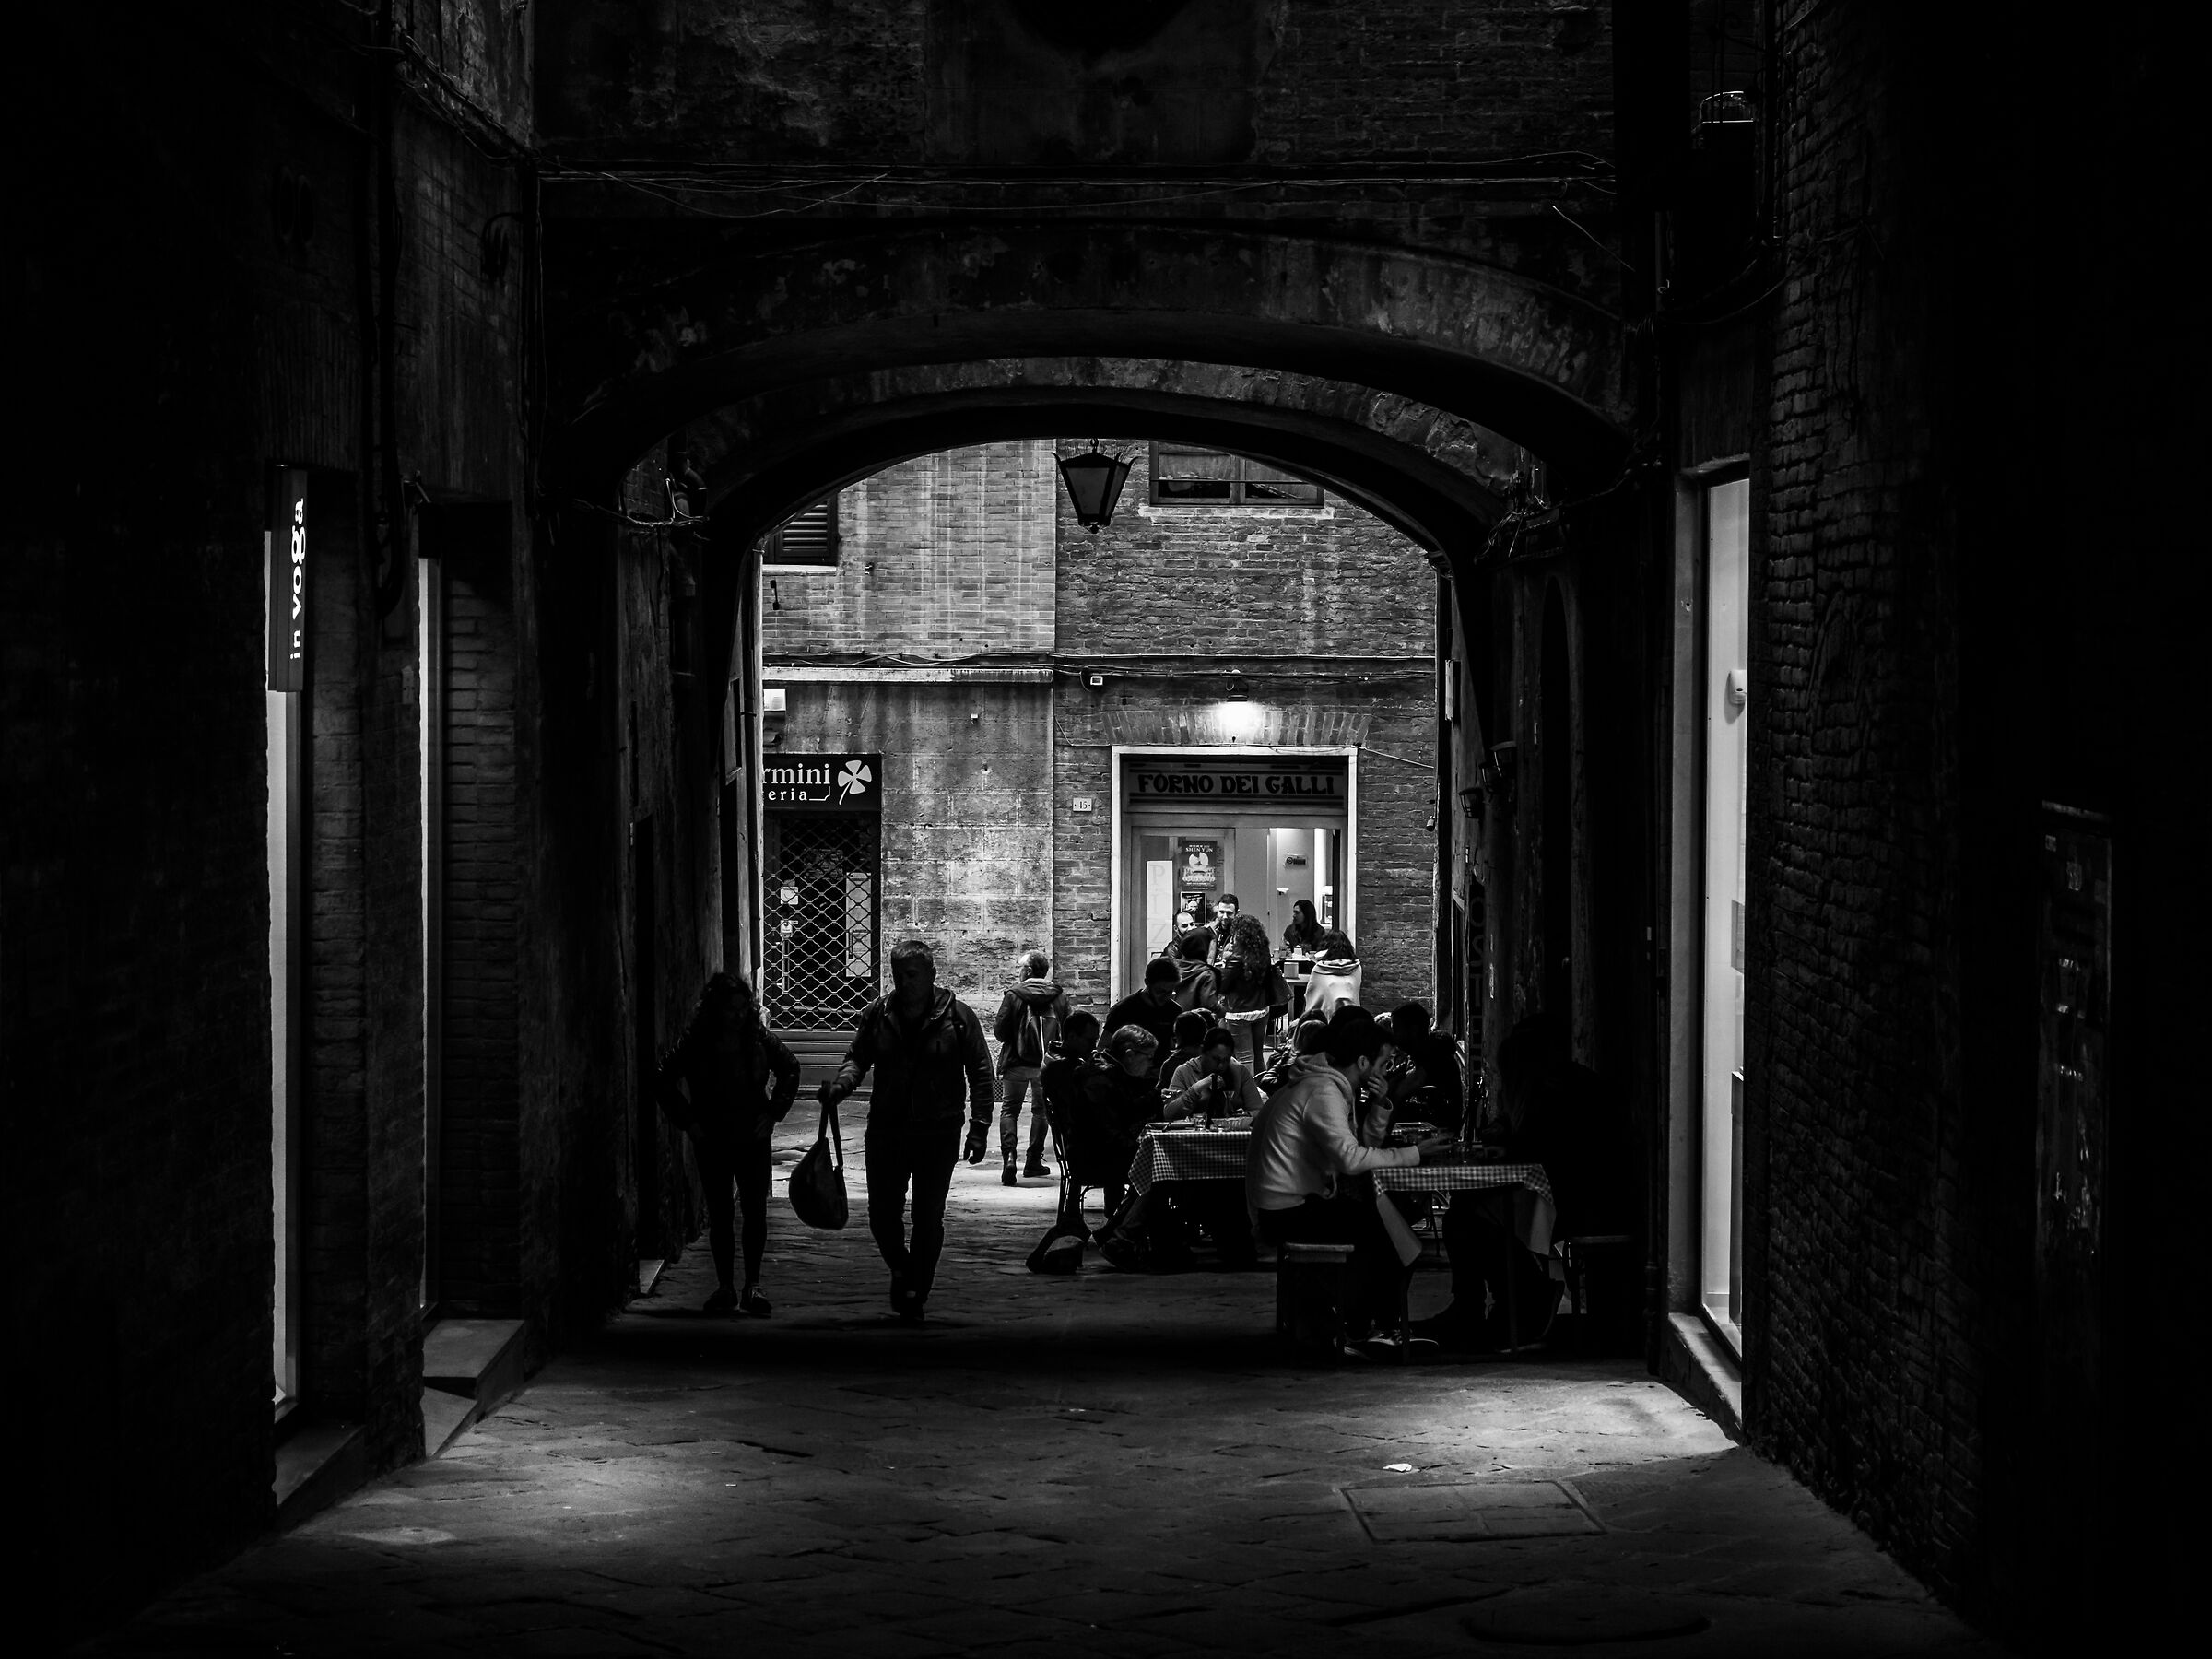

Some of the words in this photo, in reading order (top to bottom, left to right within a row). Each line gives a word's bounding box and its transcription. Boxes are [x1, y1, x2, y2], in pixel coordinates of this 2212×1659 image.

[291, 498, 306, 620] voga
[289, 629, 301, 660] in
[1137, 774, 1214, 793] FORNO
[1220, 775, 1259, 794] DEI
[1265, 776, 1335, 794] GALLI
